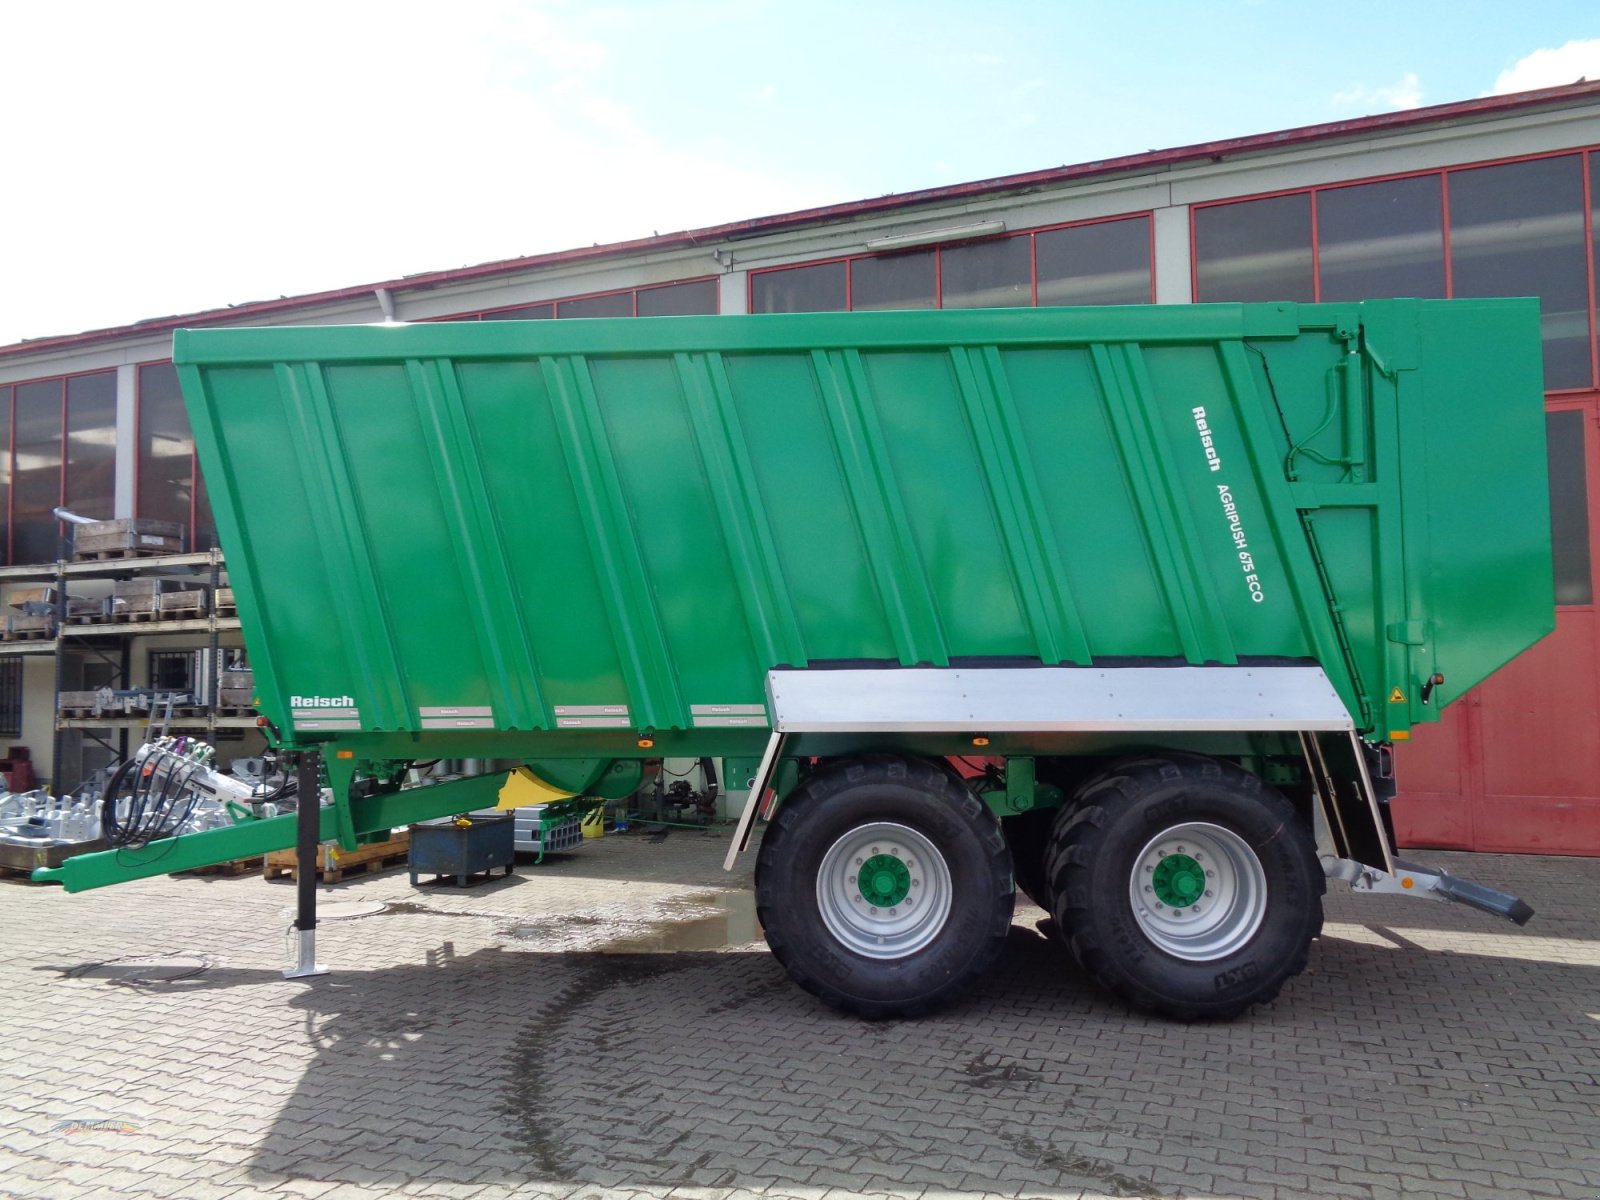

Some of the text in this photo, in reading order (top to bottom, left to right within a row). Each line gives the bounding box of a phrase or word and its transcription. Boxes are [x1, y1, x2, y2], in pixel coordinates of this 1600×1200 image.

[1191, 405, 1264, 603] Reisch AGRIPUSH 675 ECO
[290, 695, 354, 708] Reisch
[1214, 961, 1257, 989] BKT
